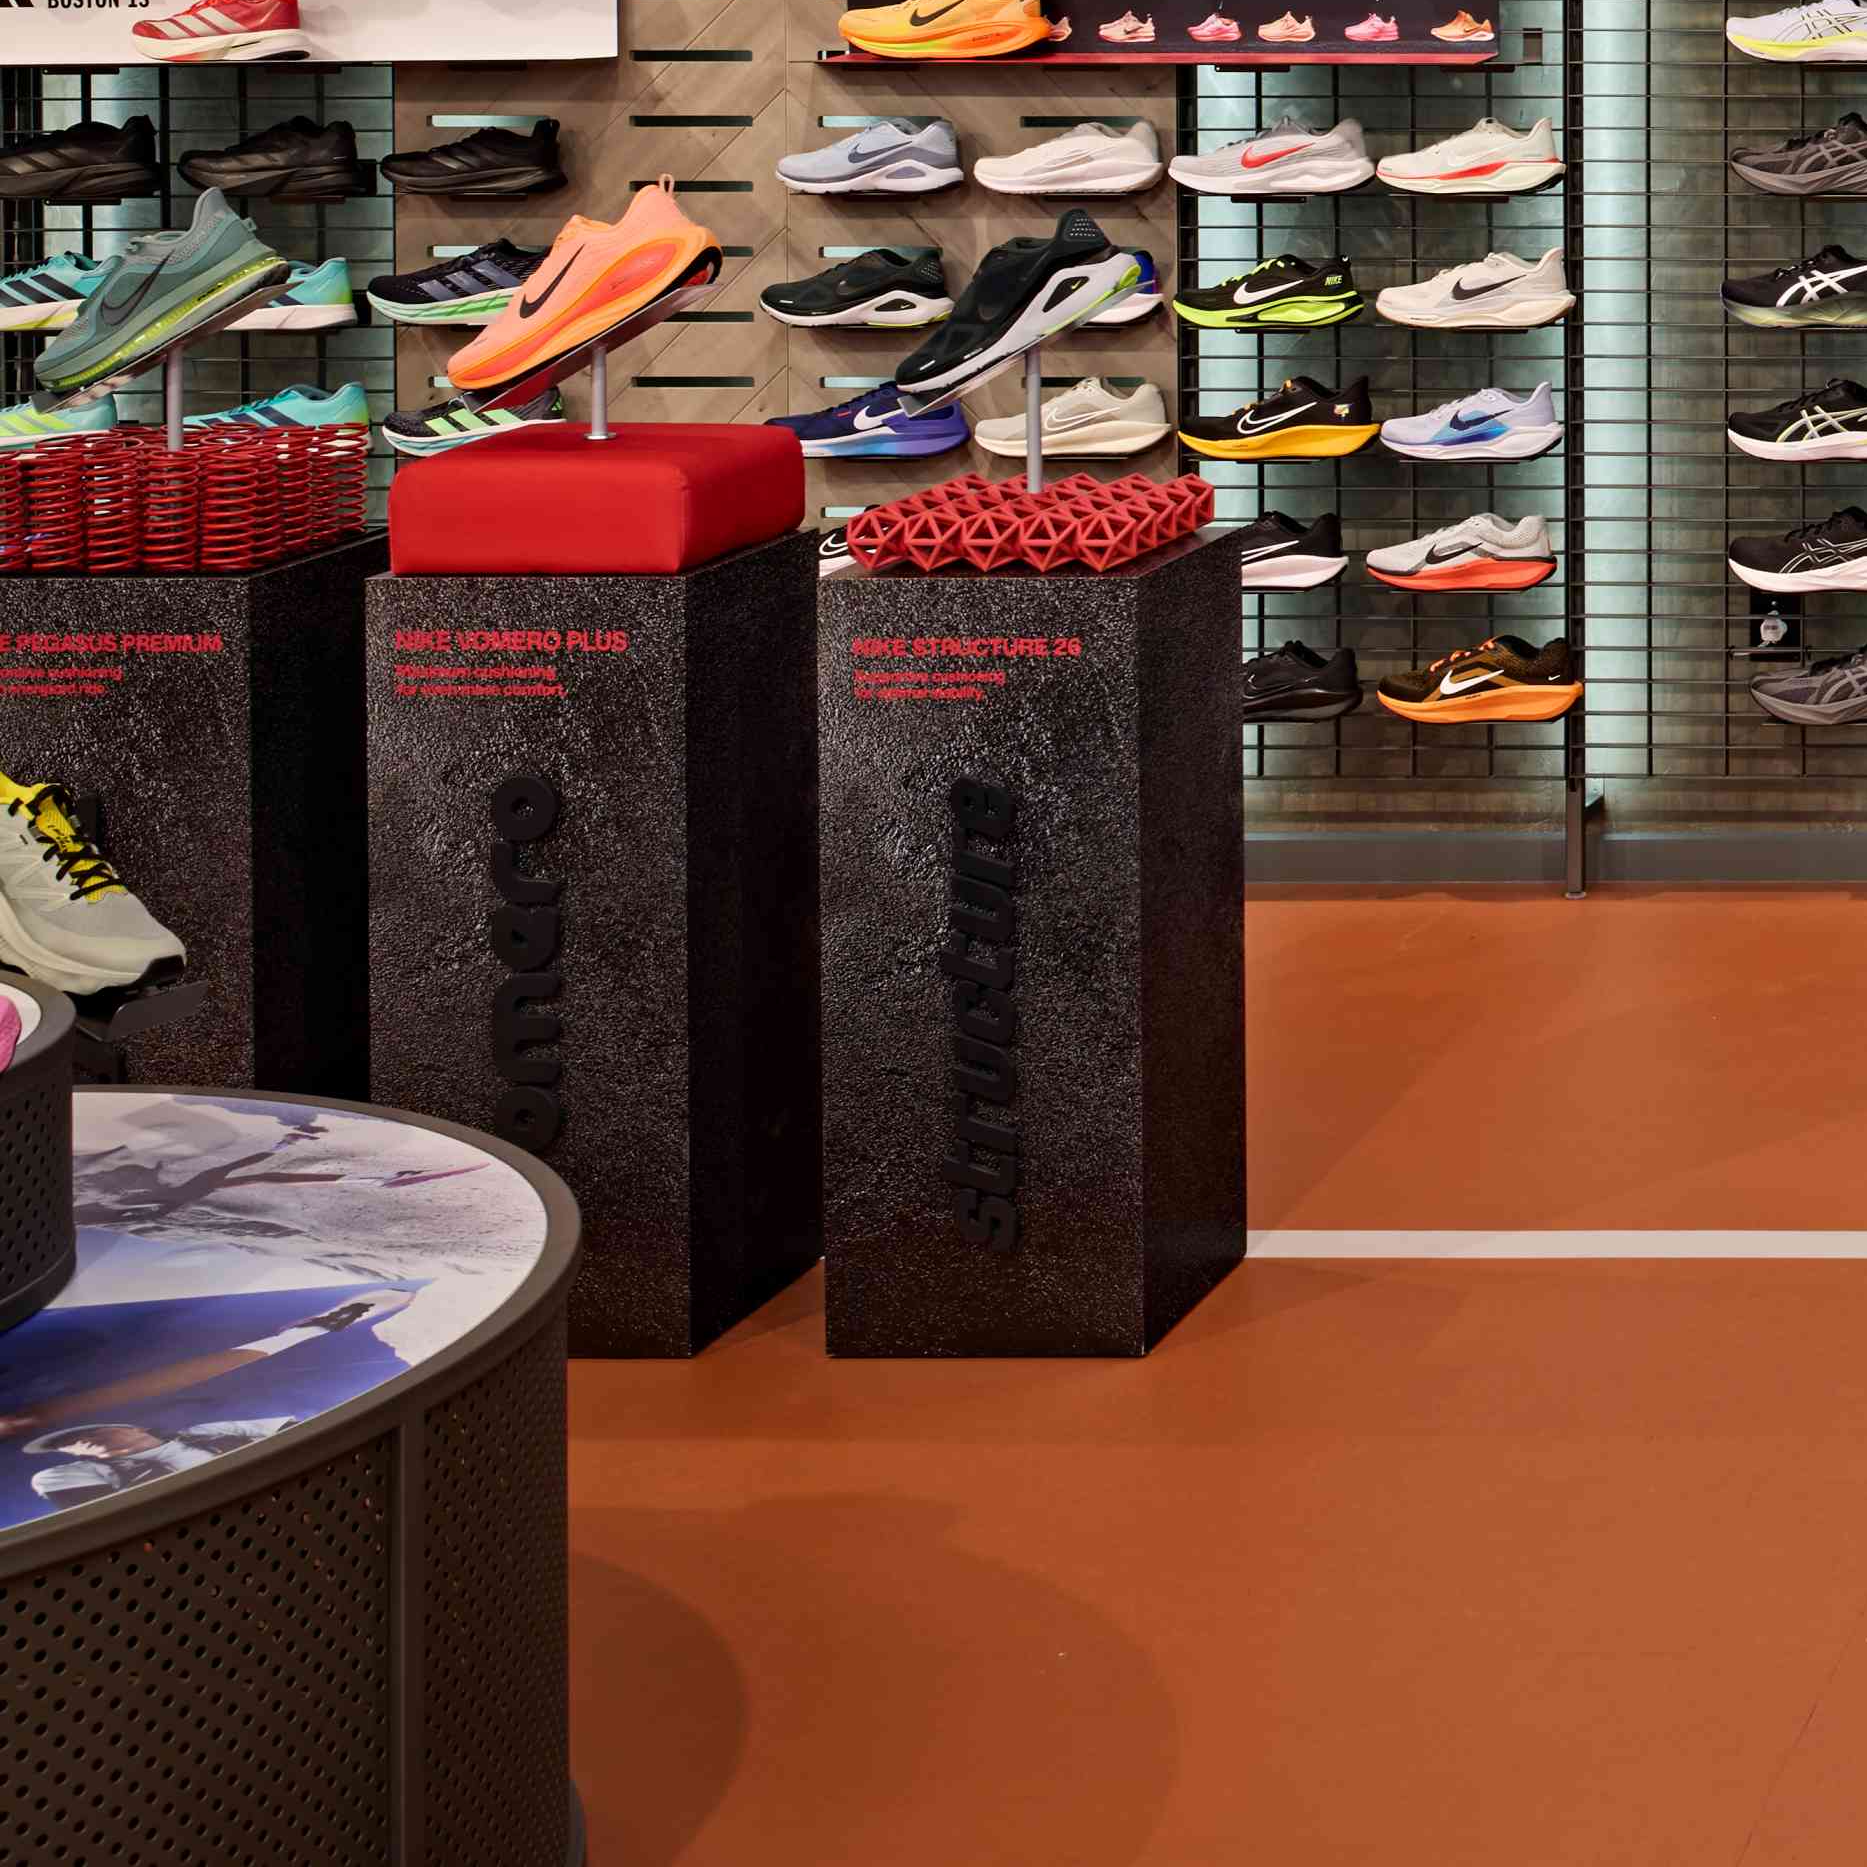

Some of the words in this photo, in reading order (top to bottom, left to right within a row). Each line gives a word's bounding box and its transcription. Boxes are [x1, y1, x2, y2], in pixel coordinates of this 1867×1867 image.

[1325, 274, 1343, 286] NIKE
[15, 633, 117, 654] PEGASUS
[121, 633, 223, 653] PREMIUM
[394, 631, 449, 652] NIKE
[453, 631, 562, 653] VOMERO
[566, 631, 629, 653] PLUS
[851, 638, 907, 658] NIKE
[910, 638, 1047, 658] STRUCTURE
[1051, 638, 1081, 657] 26
[474, 664, 556, 681] cushioning
[494, 774, 560, 1156] omero
[942, 774, 1021, 1253] structure
